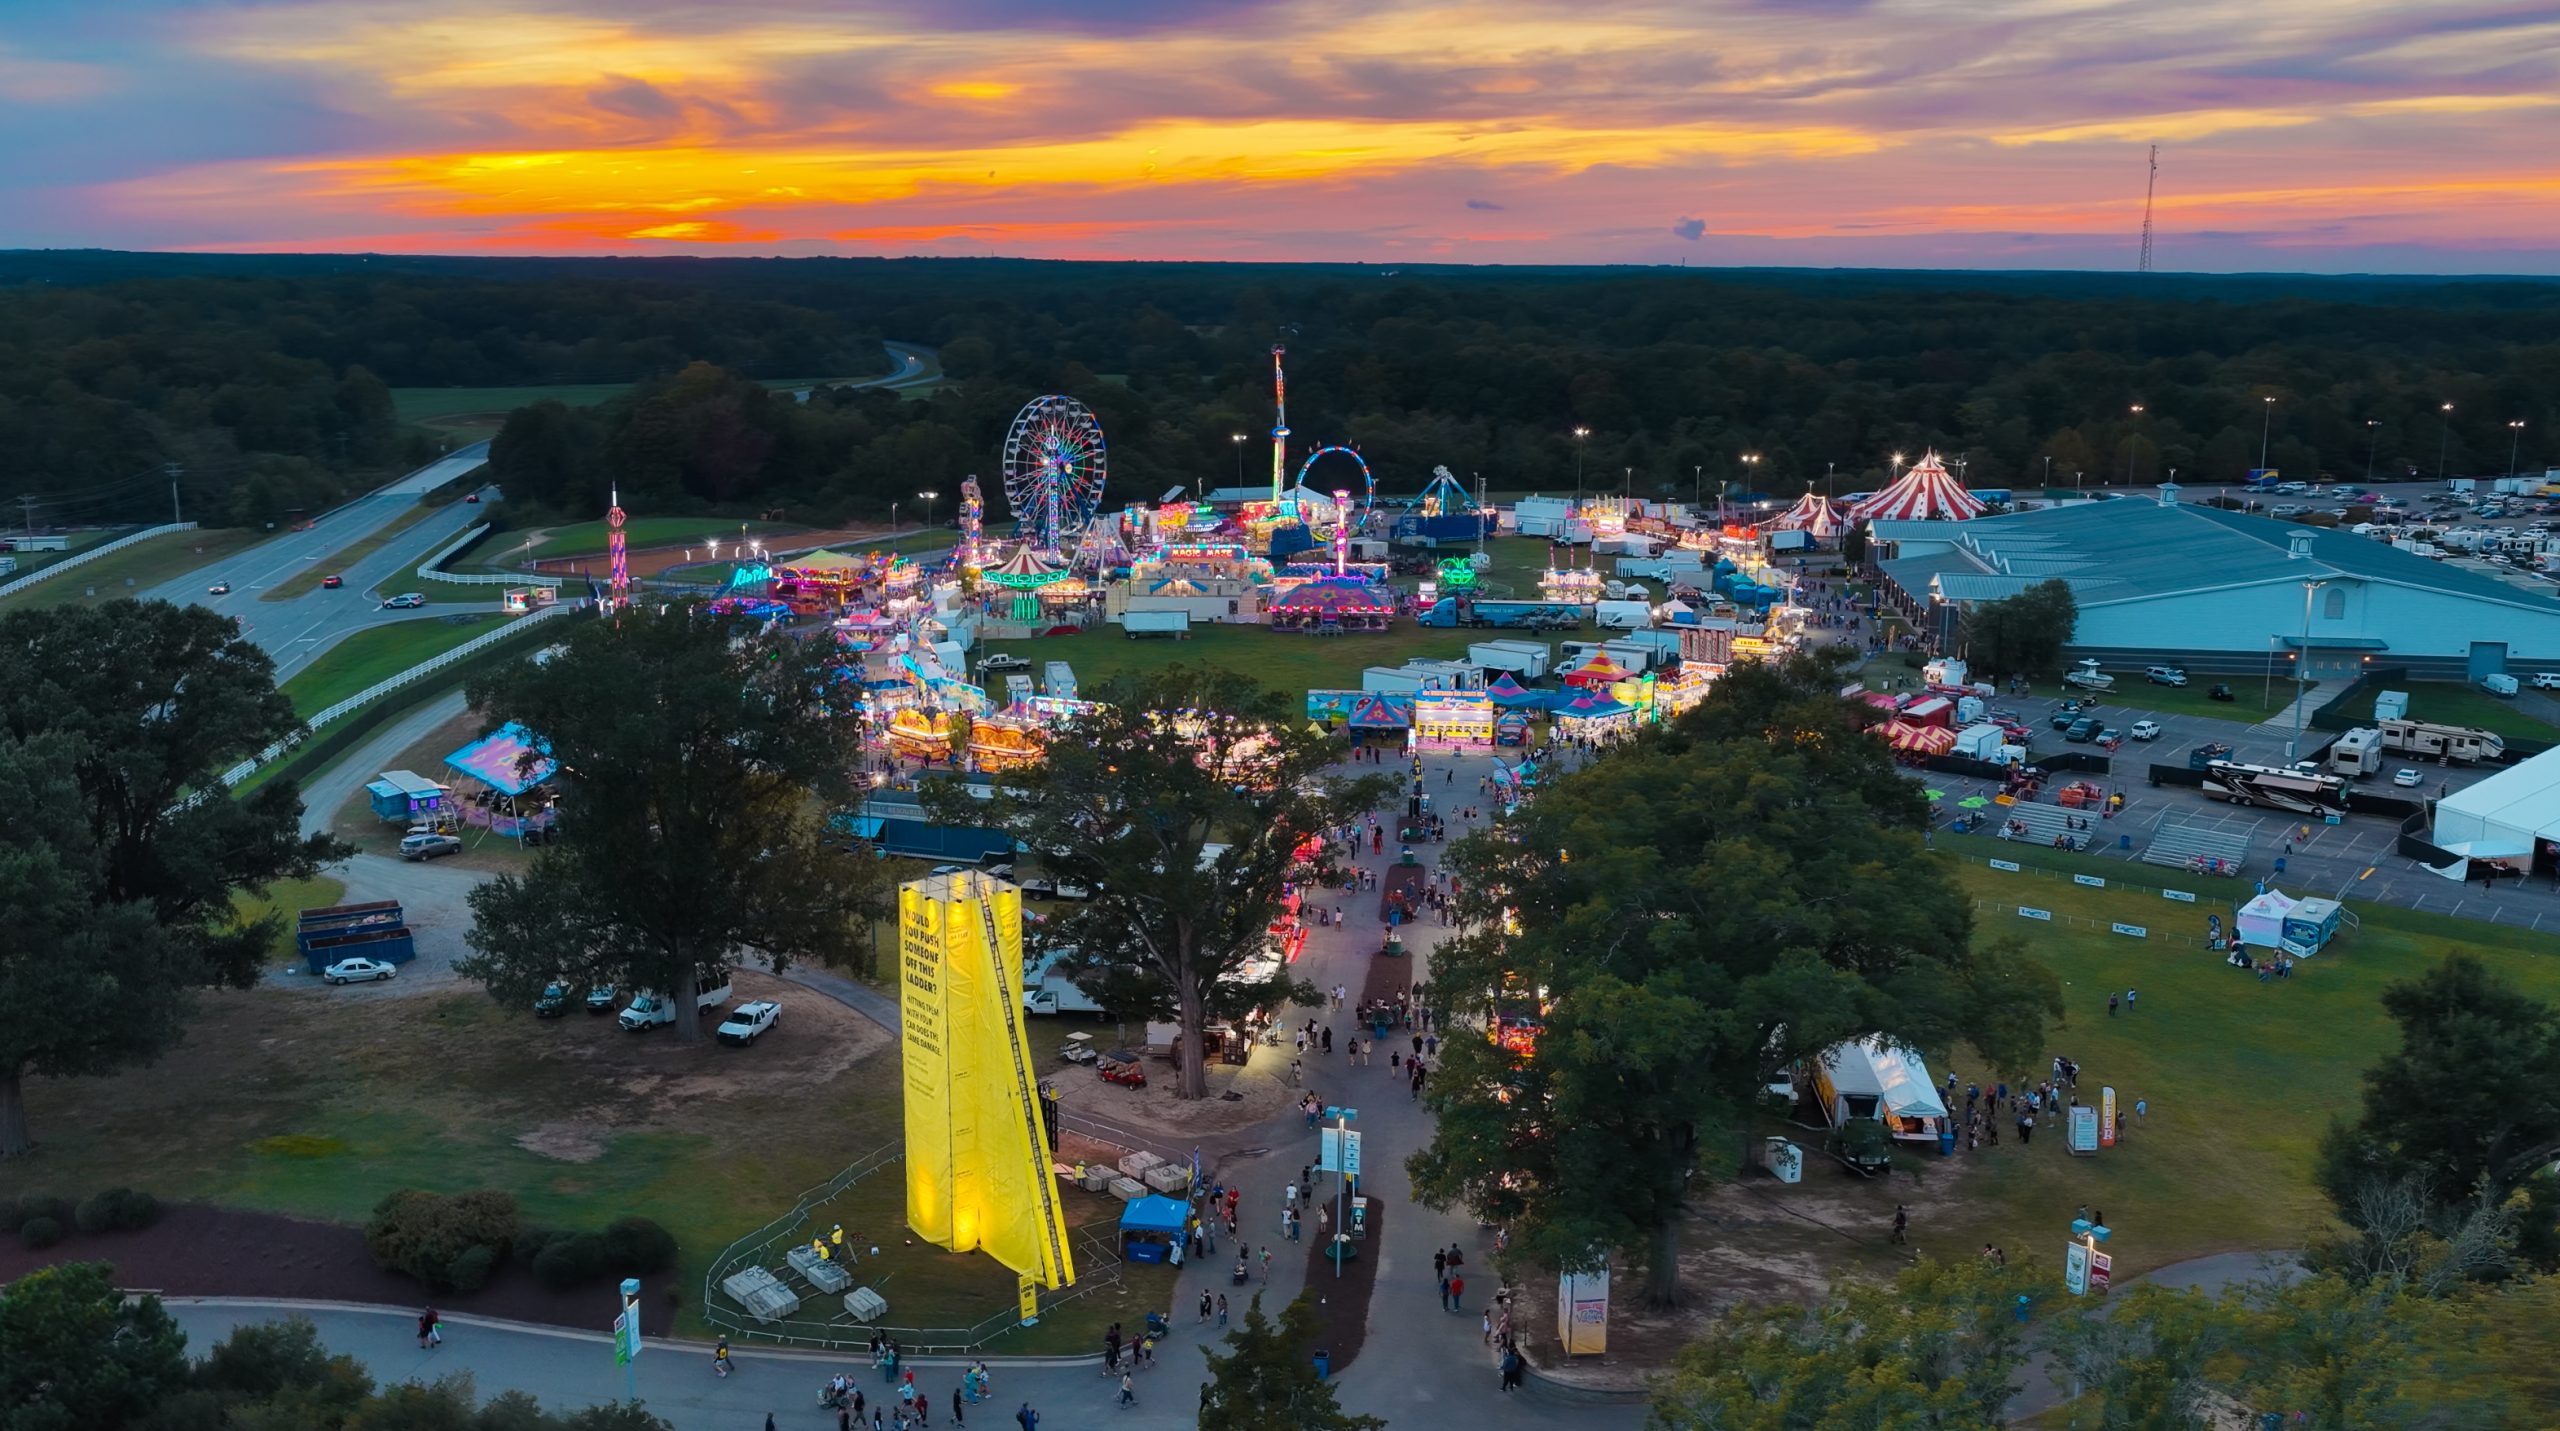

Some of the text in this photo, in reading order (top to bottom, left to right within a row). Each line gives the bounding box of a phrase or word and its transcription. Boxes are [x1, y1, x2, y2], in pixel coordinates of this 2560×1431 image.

[1172, 549, 1201, 558] MAGIC
[904, 906, 930, 928] WOULD
[904, 922, 919, 940] YOU
[920, 930, 940, 949] PUSH
[904, 939, 939, 964] SOMEONE
[905, 955, 935, 979] OFF THIS
[905, 970, 938, 996] LADDER?
[905, 1006, 920, 1021] WITH
[906, 993, 940, 1017] HITTING THEM
[905, 1019, 916, 1032] CAR
[916, 1024, 930, 1039] DOES
[906, 1031, 921, 1047] SAME
[1354, 1208, 1364, 1232] ATM
[1020, 1282, 1034, 1294] LOOK
